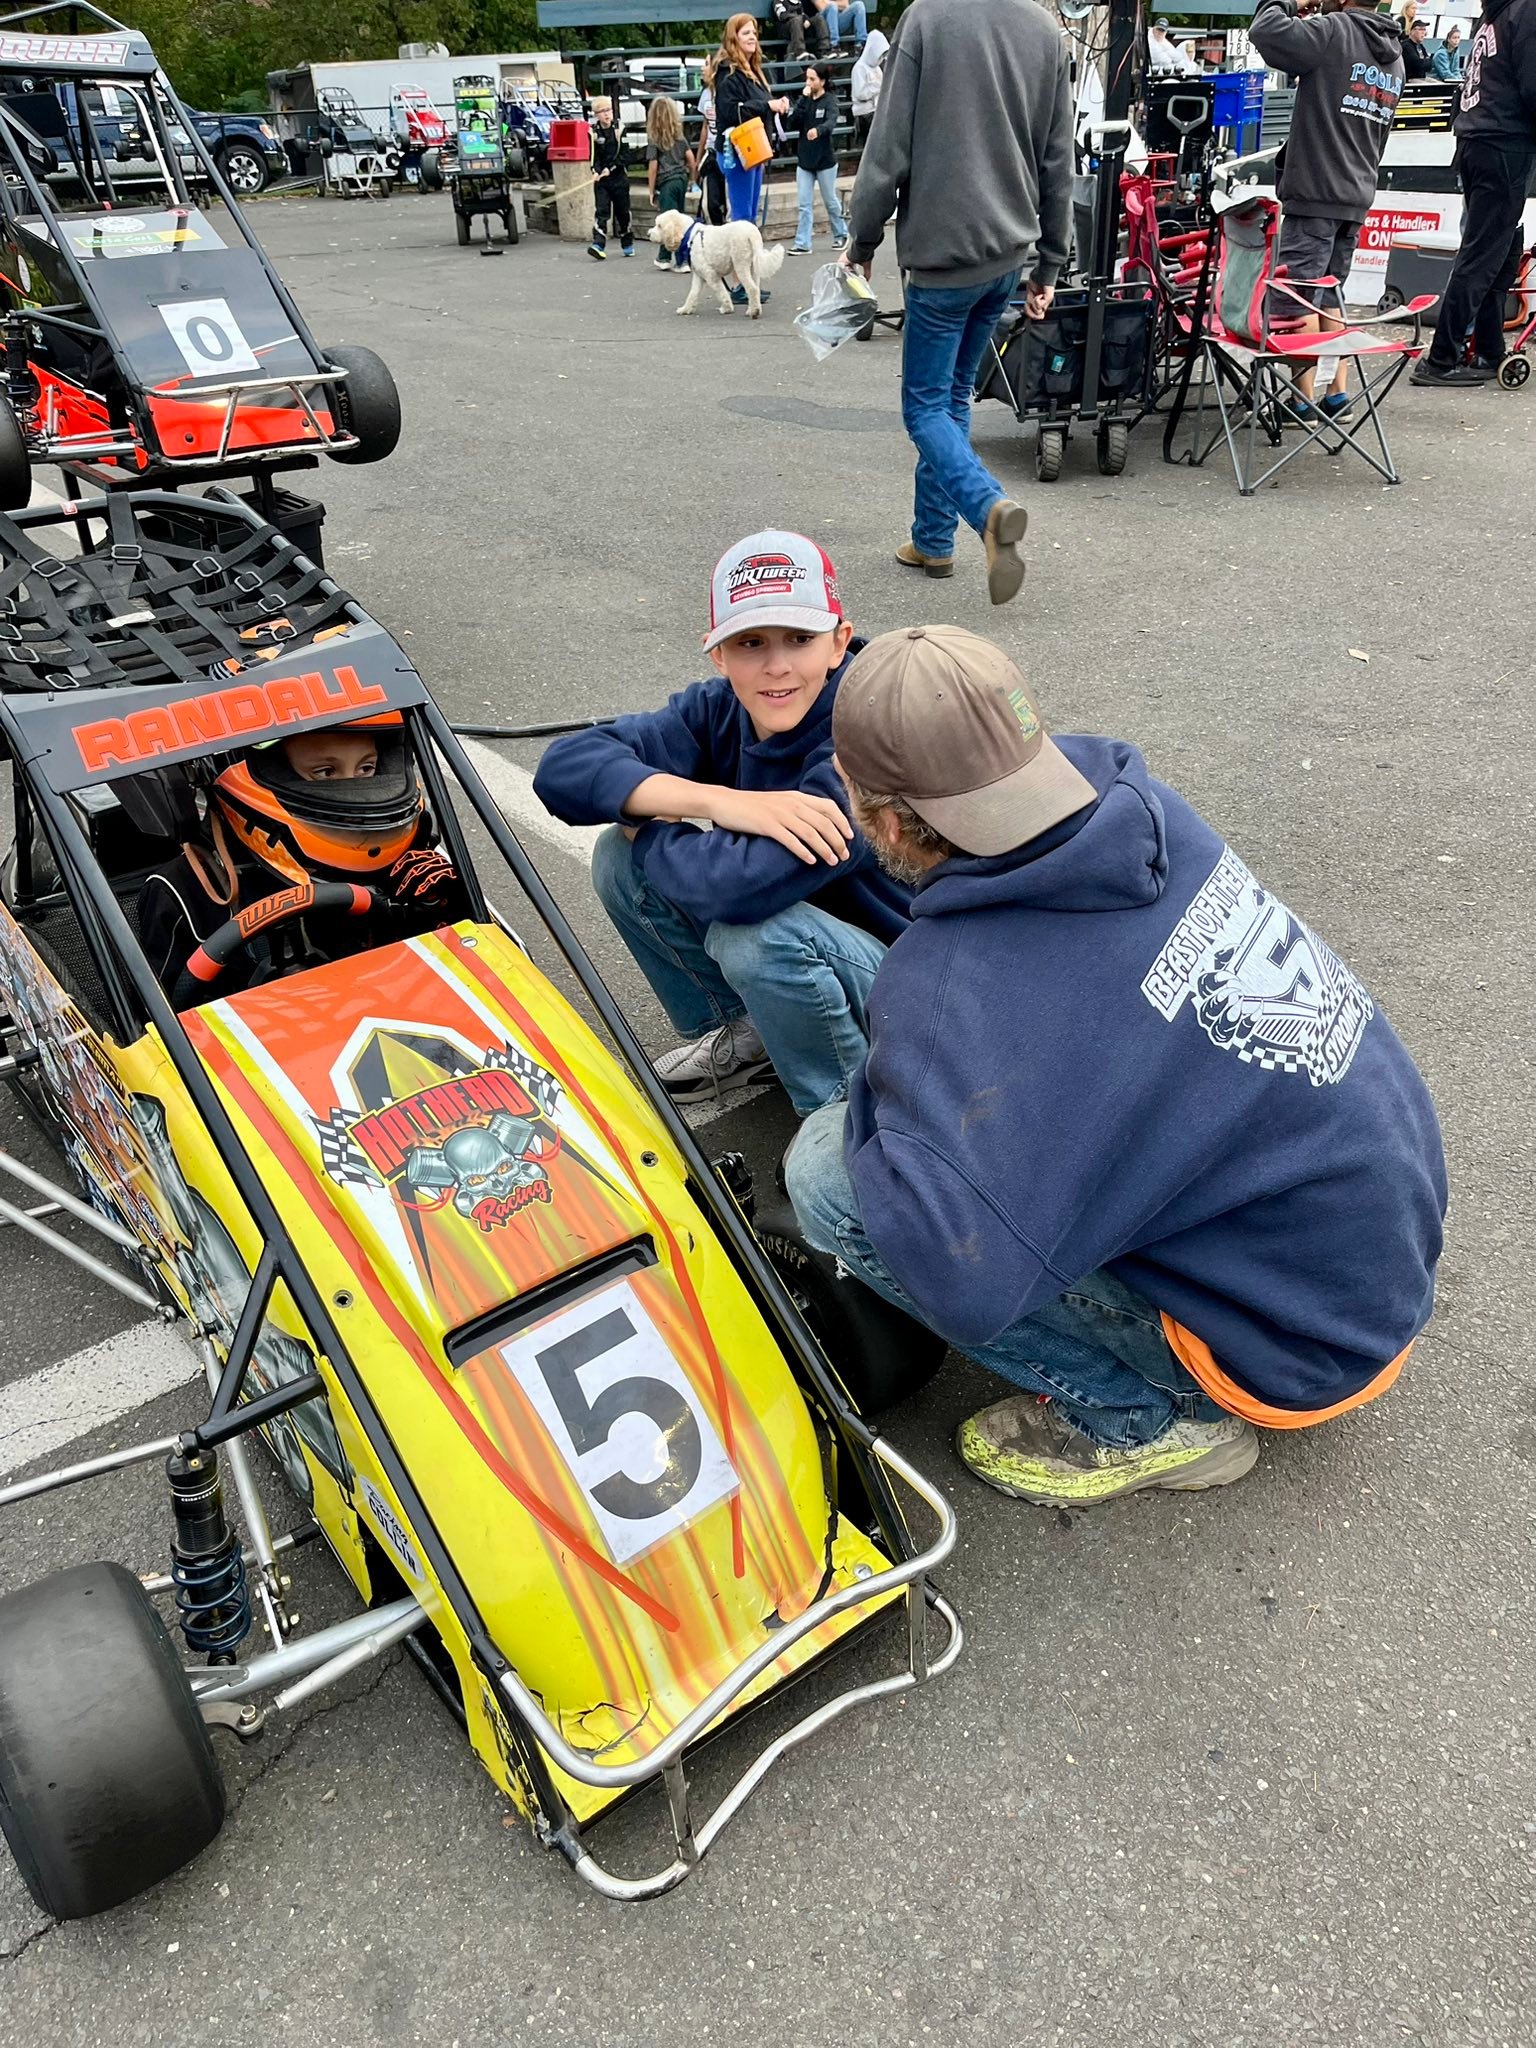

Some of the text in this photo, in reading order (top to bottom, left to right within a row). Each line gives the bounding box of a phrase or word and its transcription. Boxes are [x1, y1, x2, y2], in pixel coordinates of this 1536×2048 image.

[1381, 214, 1390, 228] &
[1392, 215, 1436, 231] Handlers
[185, 316, 234, 361] 0
[71, 666, 388, 772] RANDALL
[234, 884, 310, 933] MPI
[1205, 864, 1244, 908] THE
[1188, 896, 1224, 934] OF
[1145, 923, 1206, 1011] BEAST
[351, 1070, 535, 1176] HOTHEAD
[472, 1179, 549, 1231] Racing
[534, 1306, 702, 1520] 5
[368, 1494, 418, 1576] COLLIN
